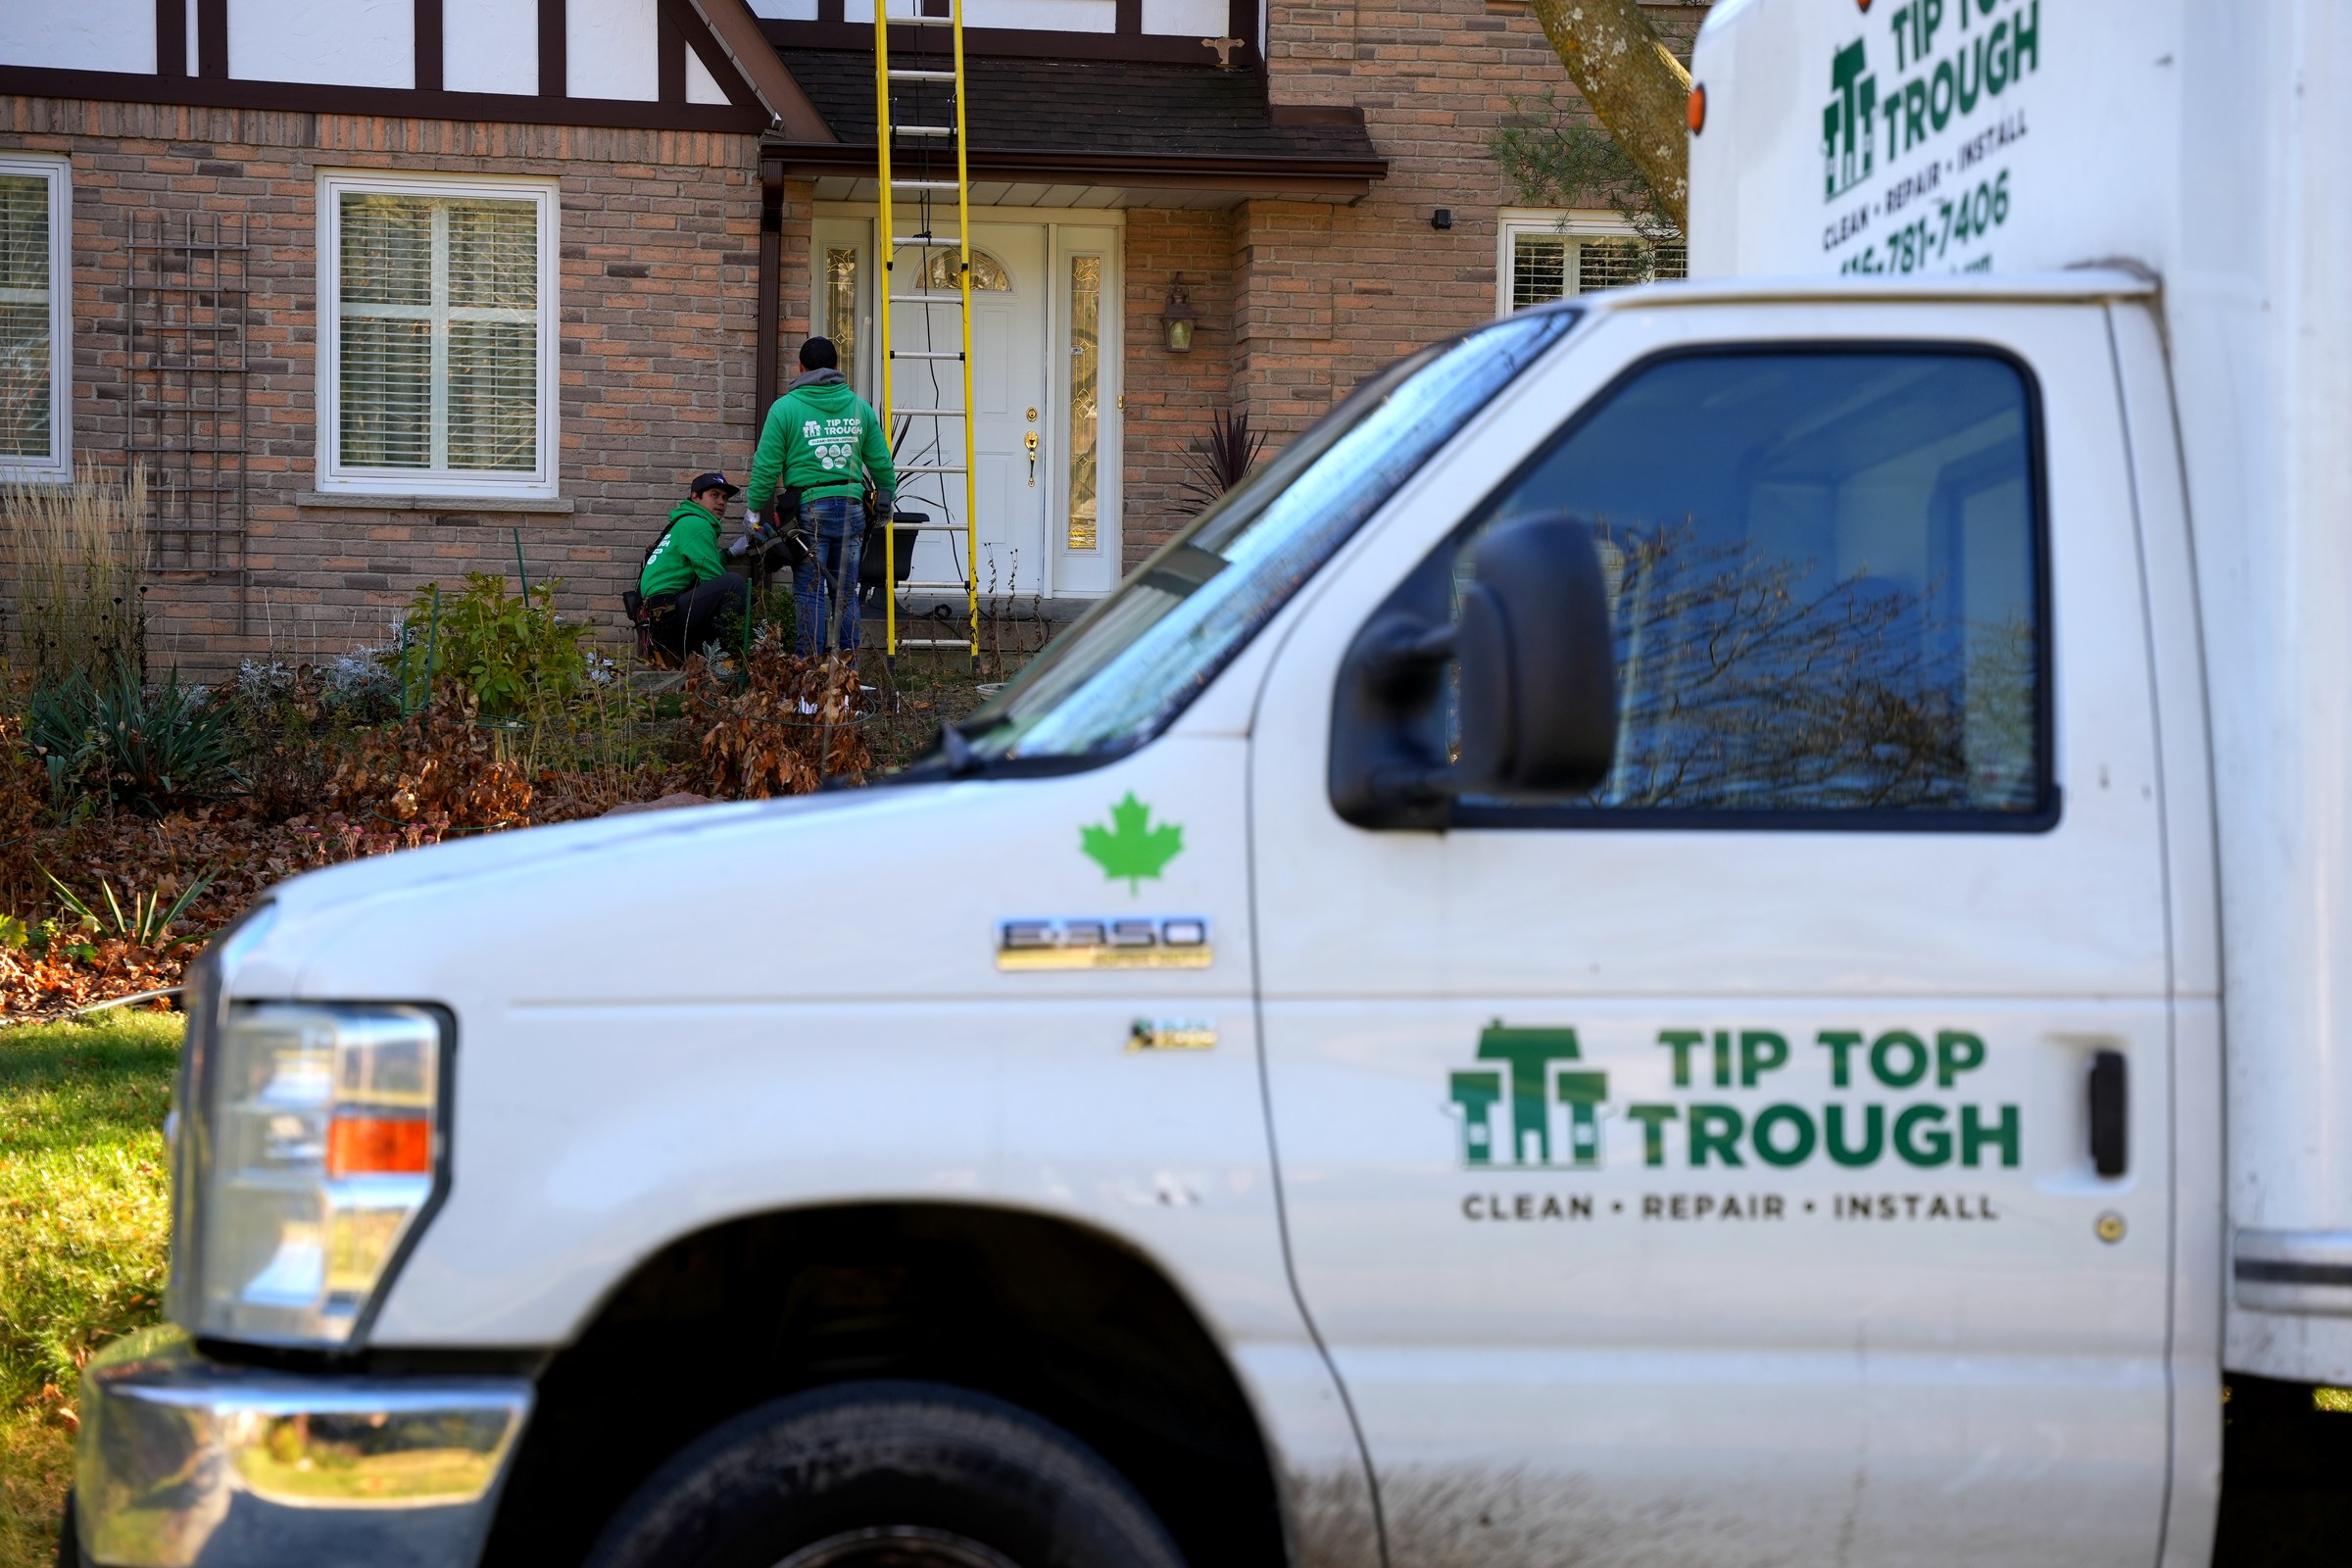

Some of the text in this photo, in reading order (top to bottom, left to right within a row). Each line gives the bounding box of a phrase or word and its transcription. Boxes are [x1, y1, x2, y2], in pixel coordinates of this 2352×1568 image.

[1891, 0, 1942, 74] TIP
[1883, 0, 2037, 164] TROUGH
[1823, 108, 2028, 252] CLEAN REPAIR INSTALL
[824, 425, 862, 435] TROUGH
[825, 417, 861, 427] TIP TOP
[1657, 1029, 1986, 1090] TIP TOP
[1627, 1102, 2021, 1170] TROUGH
[1461, 1193, 1998, 1221] CLEAN REPAIR INSTALL
